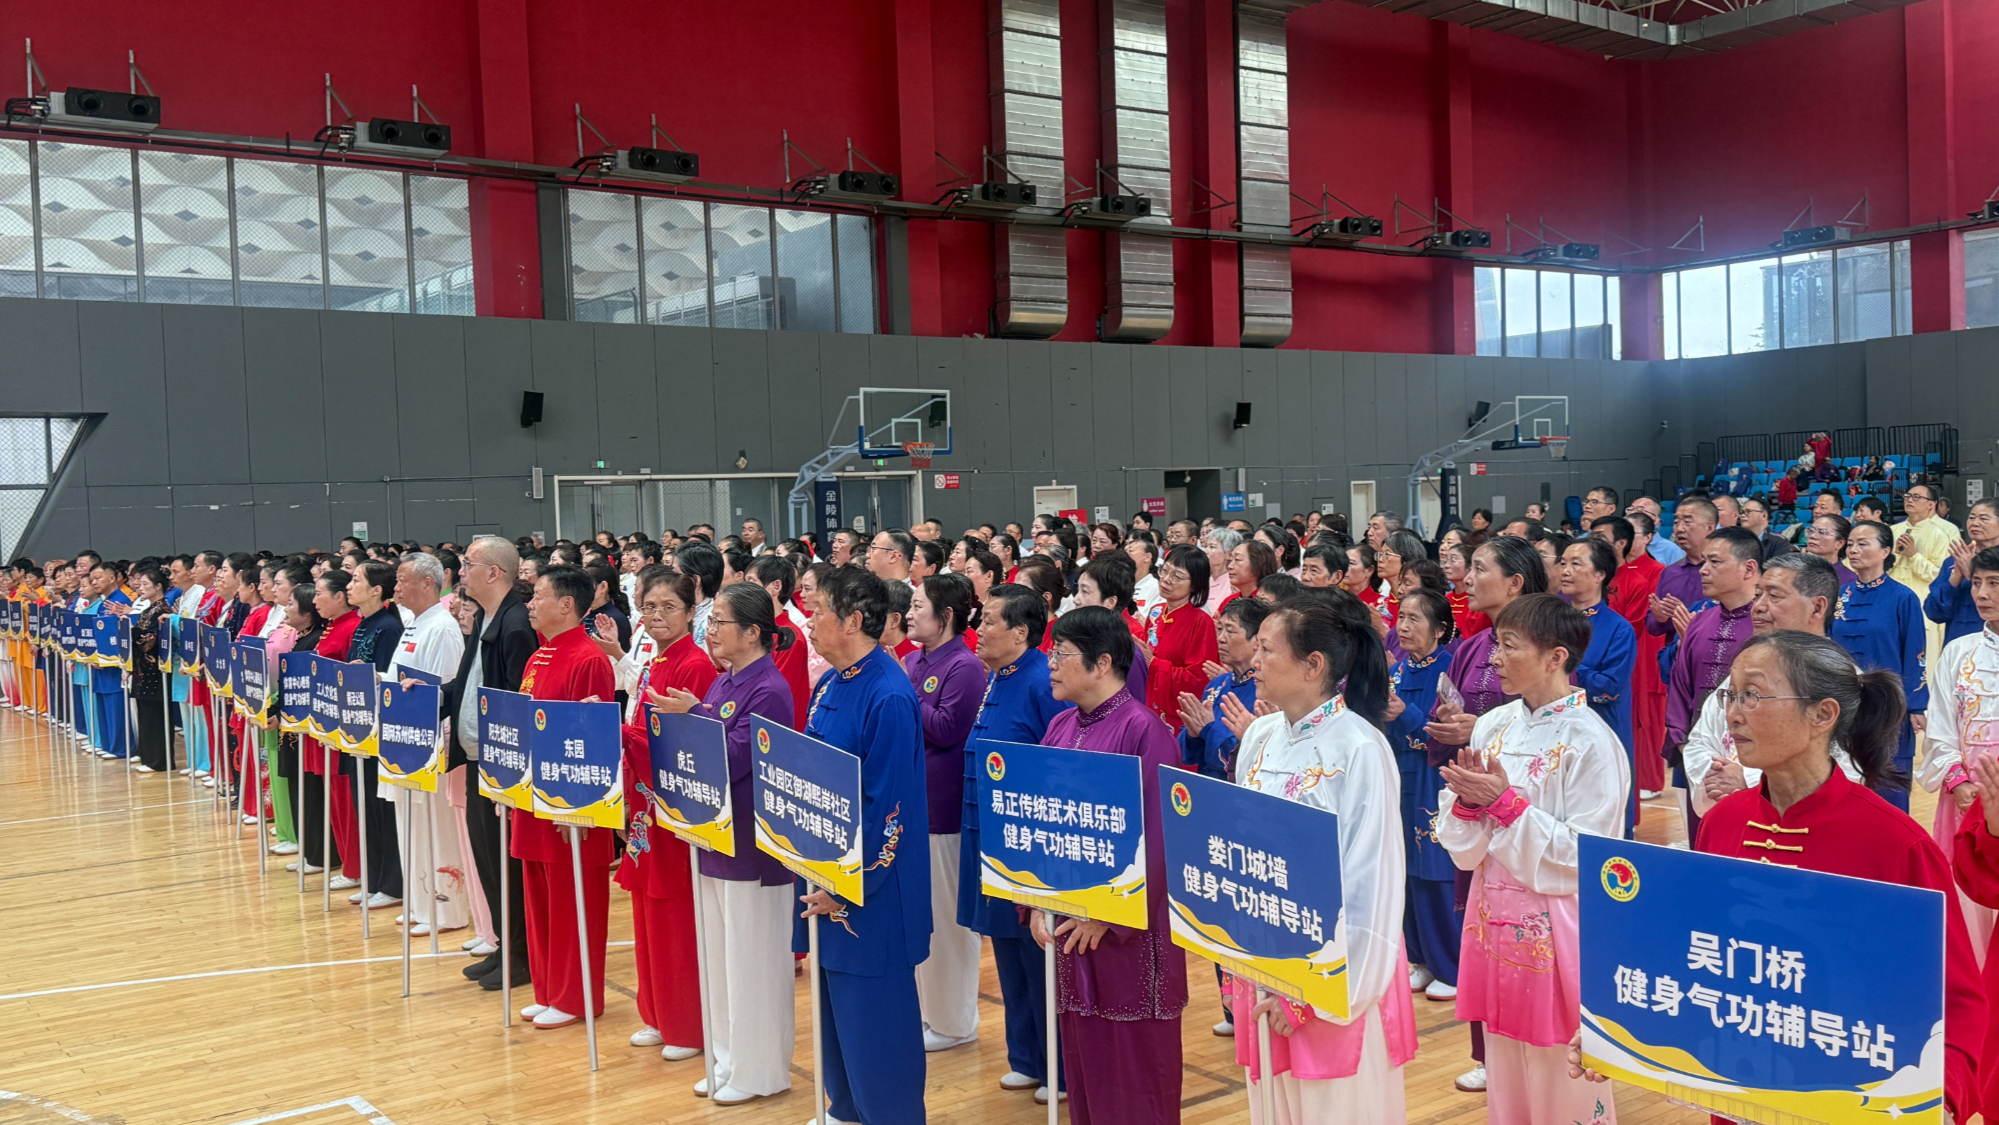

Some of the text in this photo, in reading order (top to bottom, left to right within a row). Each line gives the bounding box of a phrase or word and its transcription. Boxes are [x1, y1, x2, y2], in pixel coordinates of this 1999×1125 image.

[382, 723, 434, 748] 国网苏州供电公司
[483, 743, 526, 772] 健身气功辅导站
[488, 723, 519, 747] 阳光城社区
[564, 739, 585, 759] 东园
[541, 761, 611, 787] 健身气功辅导站
[677, 750, 696, 774] 虎丘
[659, 769, 721, 809] 健身气功辅导站
[759, 760, 851, 823] 工业园区御湖熙岸社区
[991, 789, 1126, 834] 易正传统武术俱乐部
[763, 789, 848, 851] 健身气功辅导站
[1003, 823, 1115, 868] 健身气功辅导站
[1208, 835, 1289, 890] 娄门城墙
[1183, 864, 1324, 945] 健身气功辅导站
[1687, 930, 1806, 993] 吴门桥
[1614, 965, 1895, 1071] 健身气功辅导站
